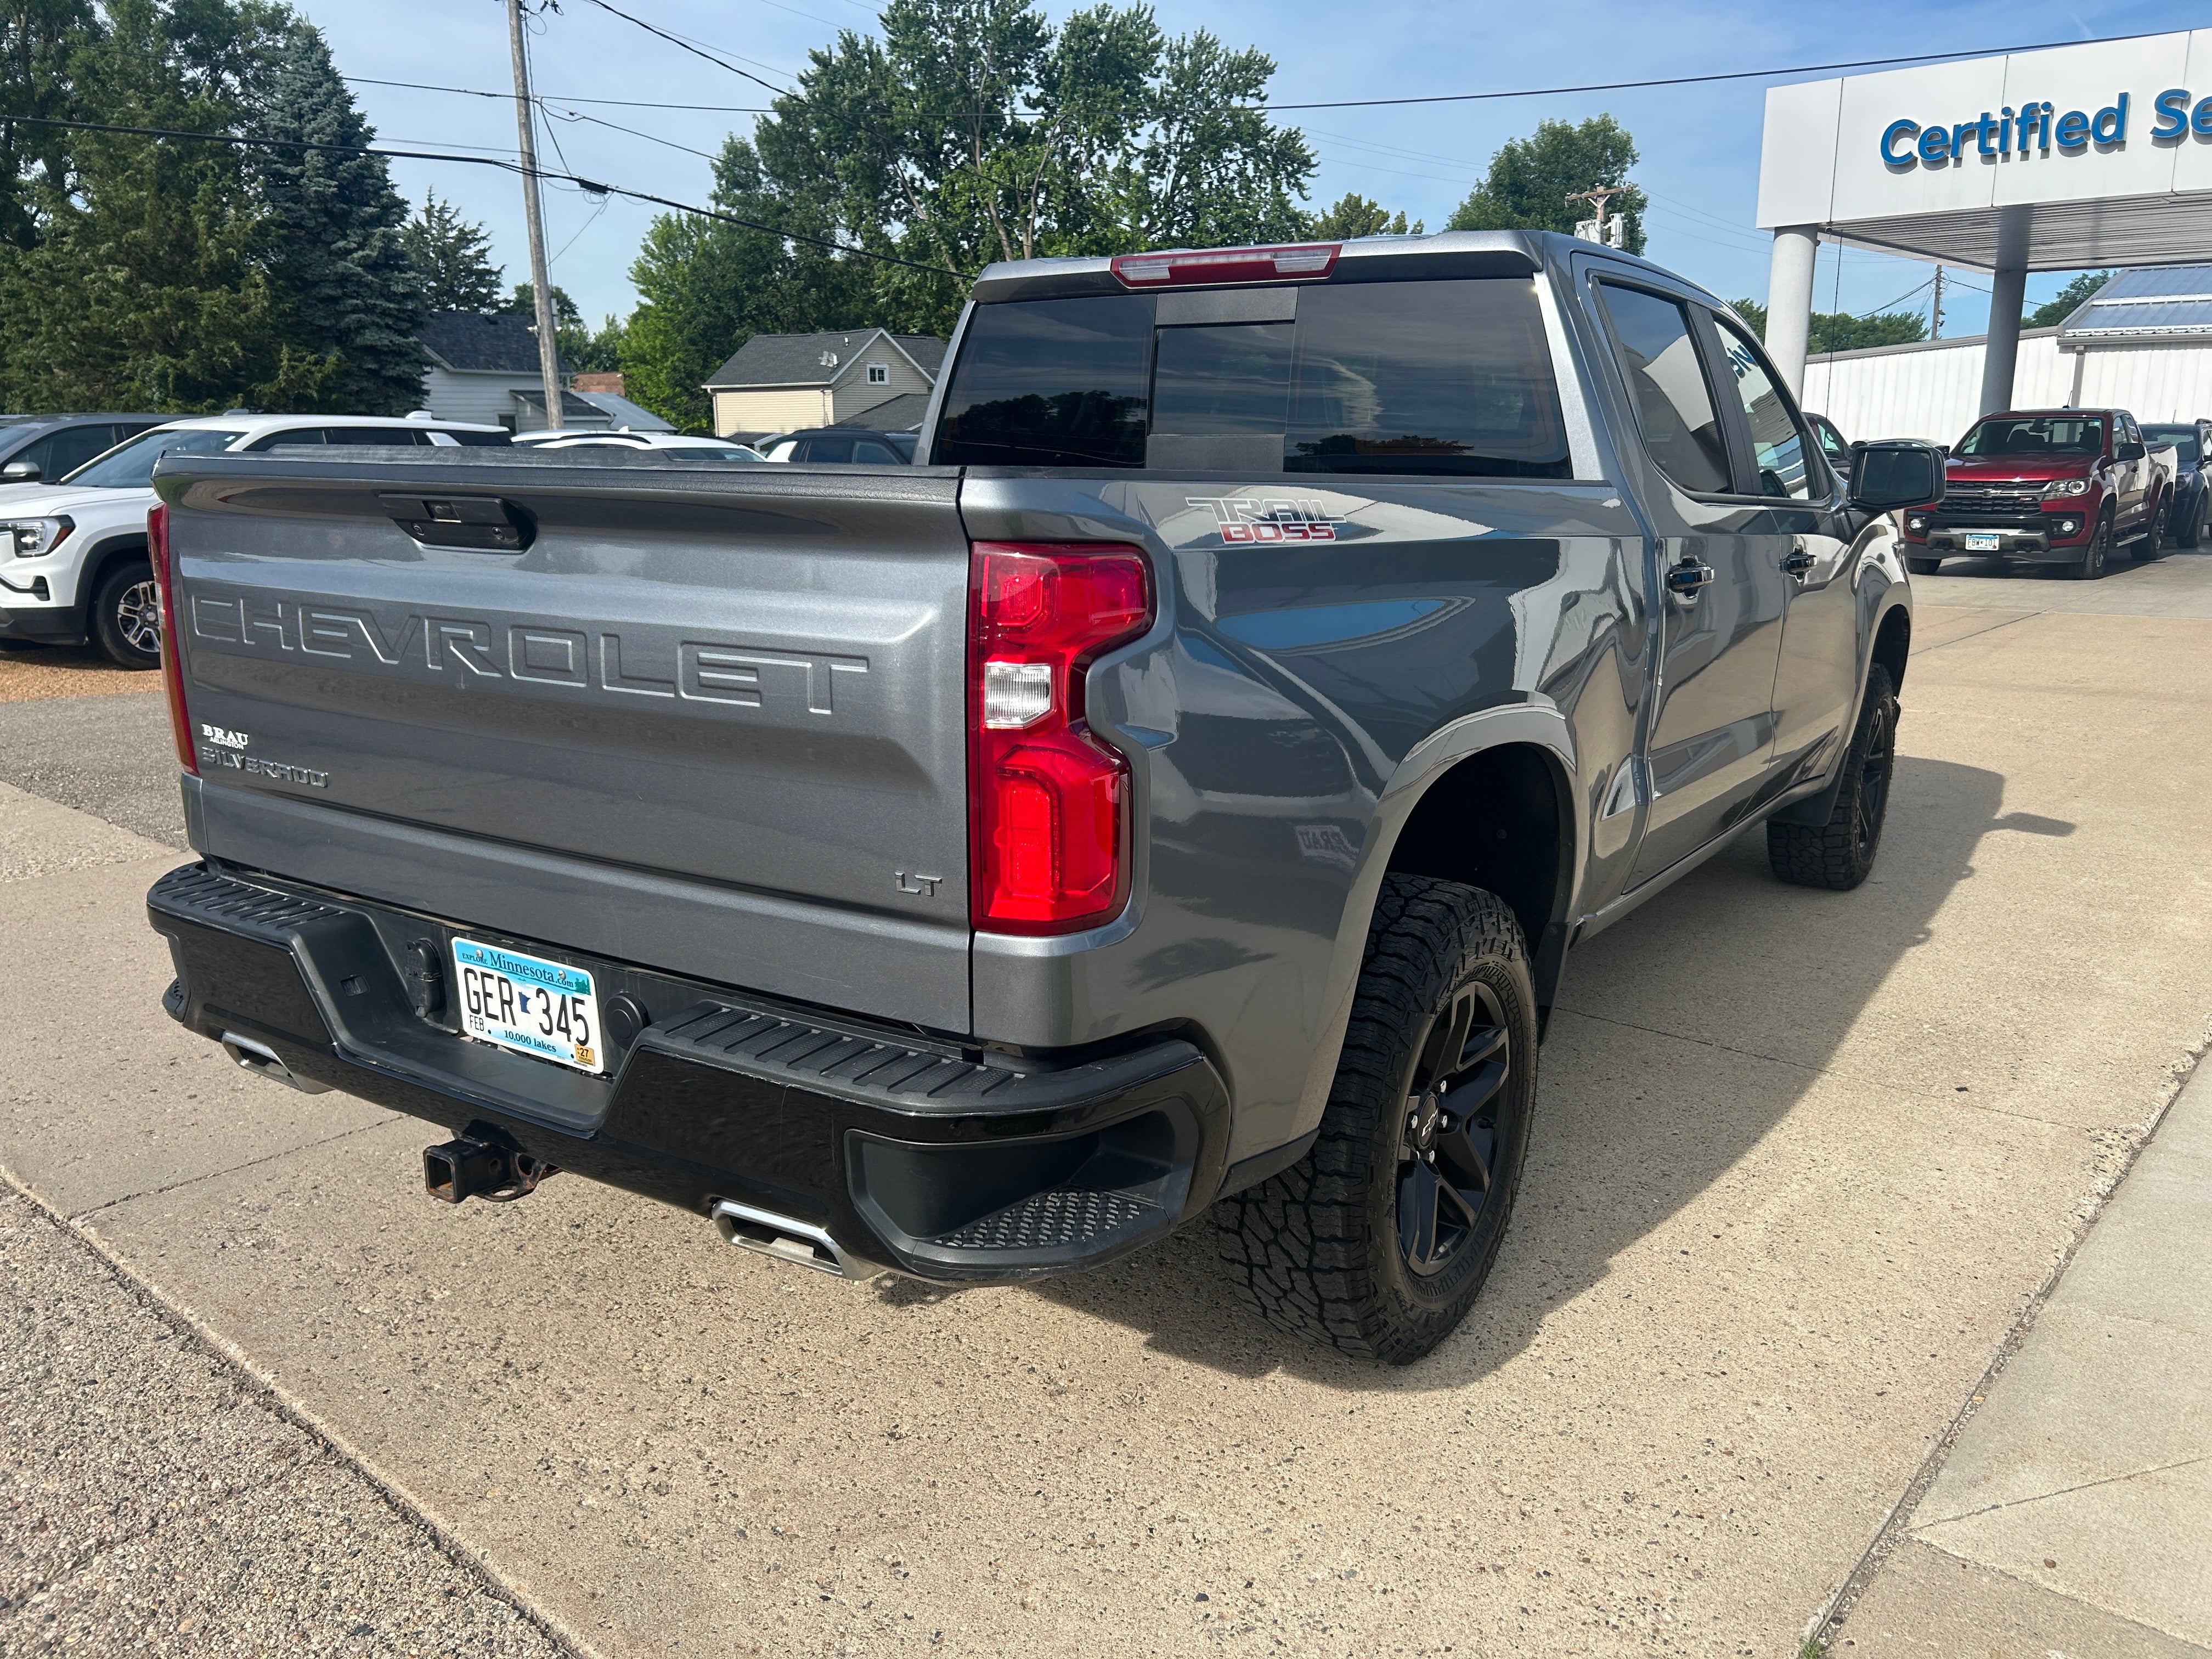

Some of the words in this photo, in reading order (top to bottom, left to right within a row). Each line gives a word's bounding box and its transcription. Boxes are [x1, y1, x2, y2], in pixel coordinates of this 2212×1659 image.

[1880, 92, 2130, 170] Certified
[2151, 89, 2212, 140] Se
[1185, 497, 1347, 523] TRAIL
[1218, 521, 1336, 544] BOSS
[191, 591, 870, 715] CHEVROLET
[201, 724, 249, 746] BRAU
[210, 736, 244, 750] ARLINGTON
[202, 747, 329, 788] SILVERADO
[895, 870, 943, 896] LT
[462, 952, 488, 965] EXPLORE
[464, 968, 516, 1026] GER
[535, 988, 590, 1046] 345
[469, 1014, 484, 1032] FEB
[504, 1030, 532, 1043] 10,000
[534, 1038, 556, 1053] lakes
[579, 1047, 589, 1058] 27
